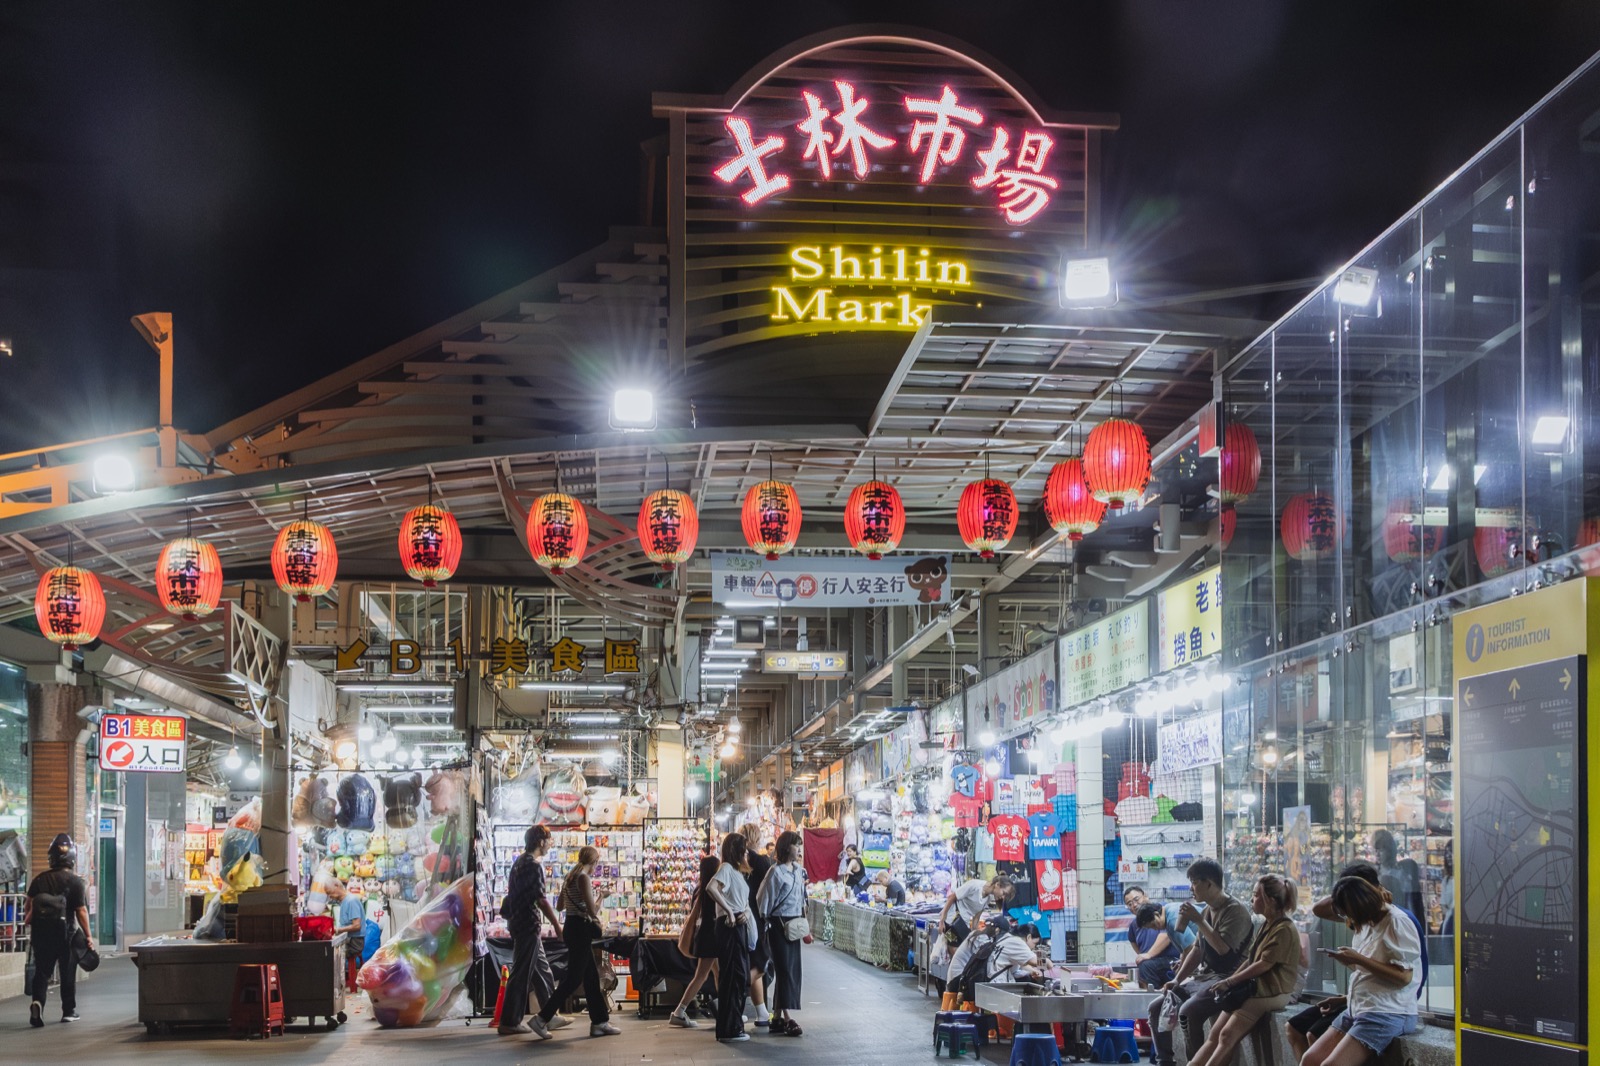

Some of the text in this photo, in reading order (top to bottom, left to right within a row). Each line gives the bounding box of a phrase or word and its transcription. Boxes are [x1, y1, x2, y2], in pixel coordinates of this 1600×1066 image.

[714, 80, 1059, 224] 士林市場
[791, 247, 971, 286] Shilin
[649, 496, 682, 553] 士林市場
[862, 488, 893, 543] 士林市場
[412, 513, 443, 567] 士林市場
[168, 548, 201, 605] 士林市場
[1487, 618, 1526, 638] TOURIST
[1487, 628, 1551, 655] INFORMATION
[491, 637, 640, 675] 美食區
[106, 717, 181, 738] B1 美食區
[138, 745, 180, 765] 入口
[373, 909, 385, 923] 中
